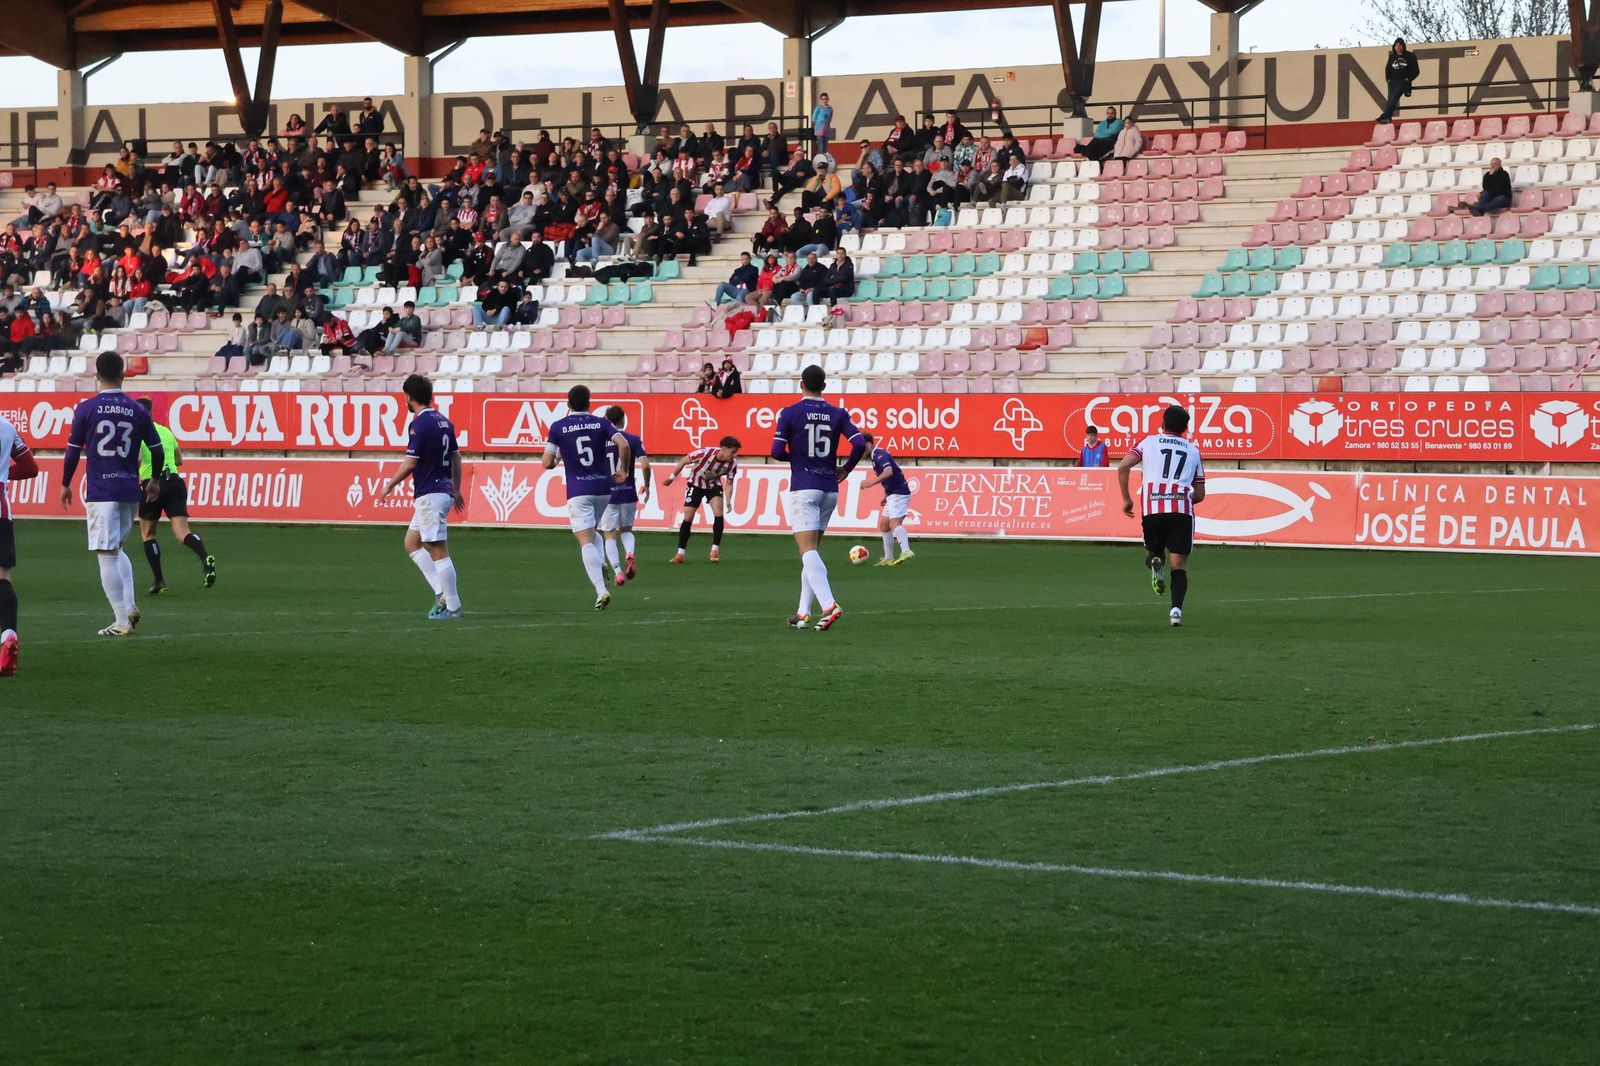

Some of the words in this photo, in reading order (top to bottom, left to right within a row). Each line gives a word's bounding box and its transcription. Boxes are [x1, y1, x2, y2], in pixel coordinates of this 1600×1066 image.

[444, 94, 548, 155] DE
[97, 405, 134, 417] J.CASADO
[806, 412, 831, 422] VICTOR
[886, 397, 960, 430] salud
[1347, 401, 1512, 412] ORTOPEDIA
[168, 394, 285, 446] CAJA
[562, 422, 601, 434] D.GALLARDO
[1344, 415, 1405, 438] tres
[1415, 418, 1515, 438] cruces
[96, 419, 134, 458] 23
[442, 433, 450, 467] 2
[804, 423, 832, 458] 15
[874, 436, 960, 451] ZAMORA
[1194, 437, 1254, 449] AMONES
[1344, 441, 1371, 449] Zamora
[1377, 441, 1390, 449] 980
[1391, 441, 1400, 449] 52
[1424, 442, 1463, 450] Benavente
[575, 435, 594, 467] 5
[1160, 448, 1188, 480] 17
[925, 473, 1052, 494] TERNERA
[1359, 479, 1466, 503] CLÍNICA
[1485, 485, 1587, 506] DENTAL
[926, 518, 1051, 529] www.terneradealiste.es
[1355, 505, 1427, 543] JOSÉ
[1438, 515, 1478, 545] DE
[1489, 516, 1586, 549] PAULA
